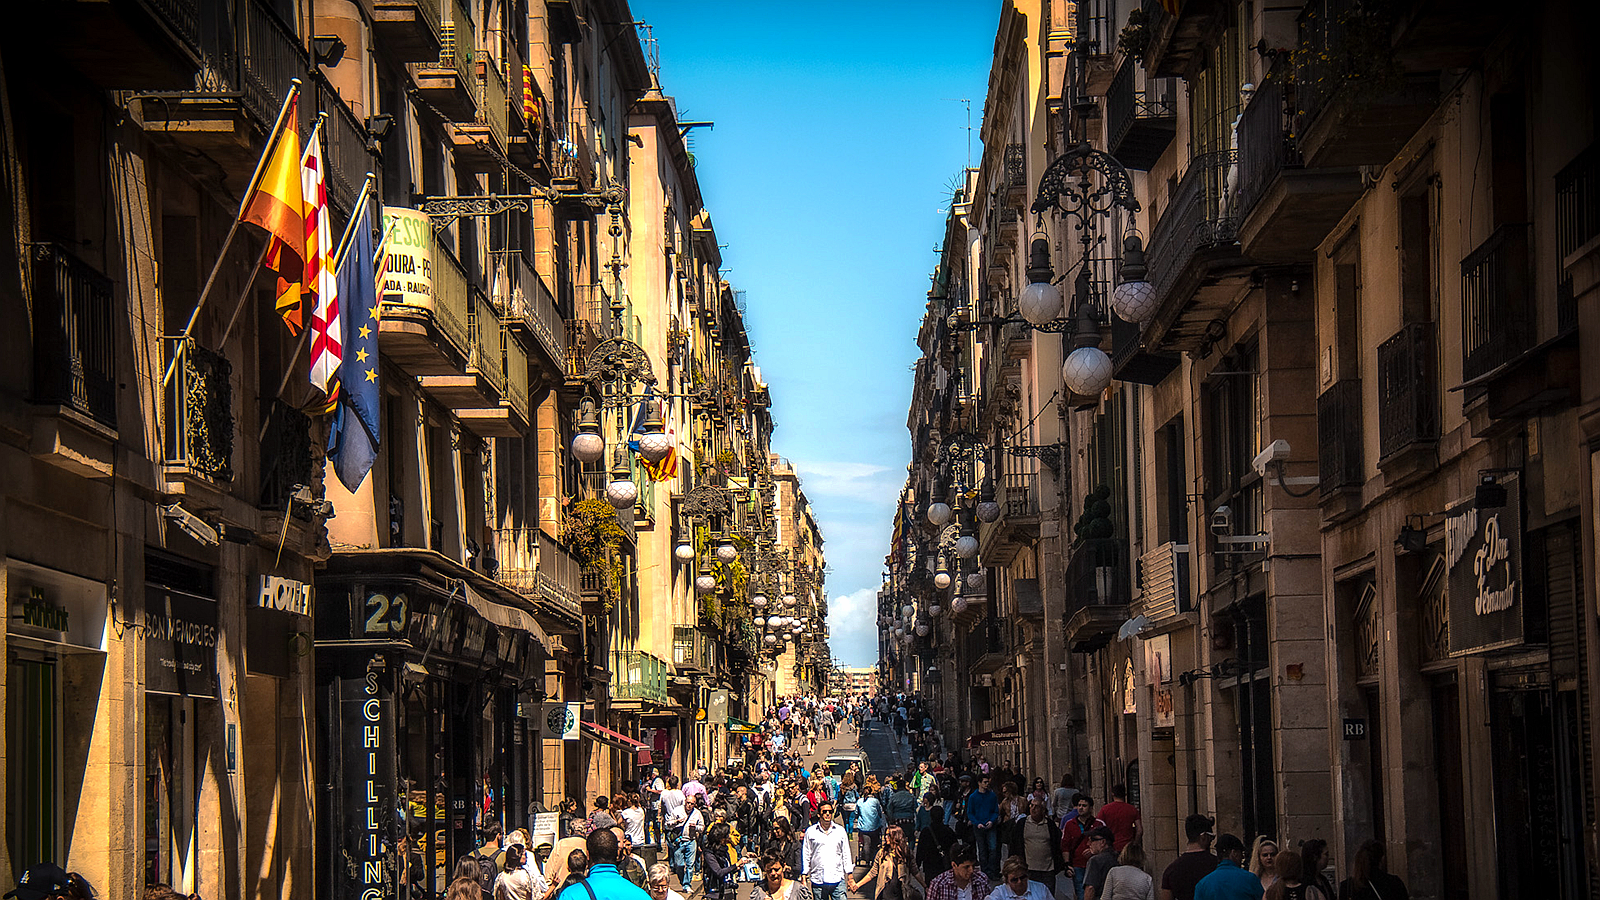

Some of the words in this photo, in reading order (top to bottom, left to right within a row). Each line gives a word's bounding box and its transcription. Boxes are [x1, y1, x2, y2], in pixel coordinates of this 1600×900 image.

[365, 593, 408, 633] 23
[167, 617, 215, 649] MEMORIES
[1345, 723, 1364, 735] RB
